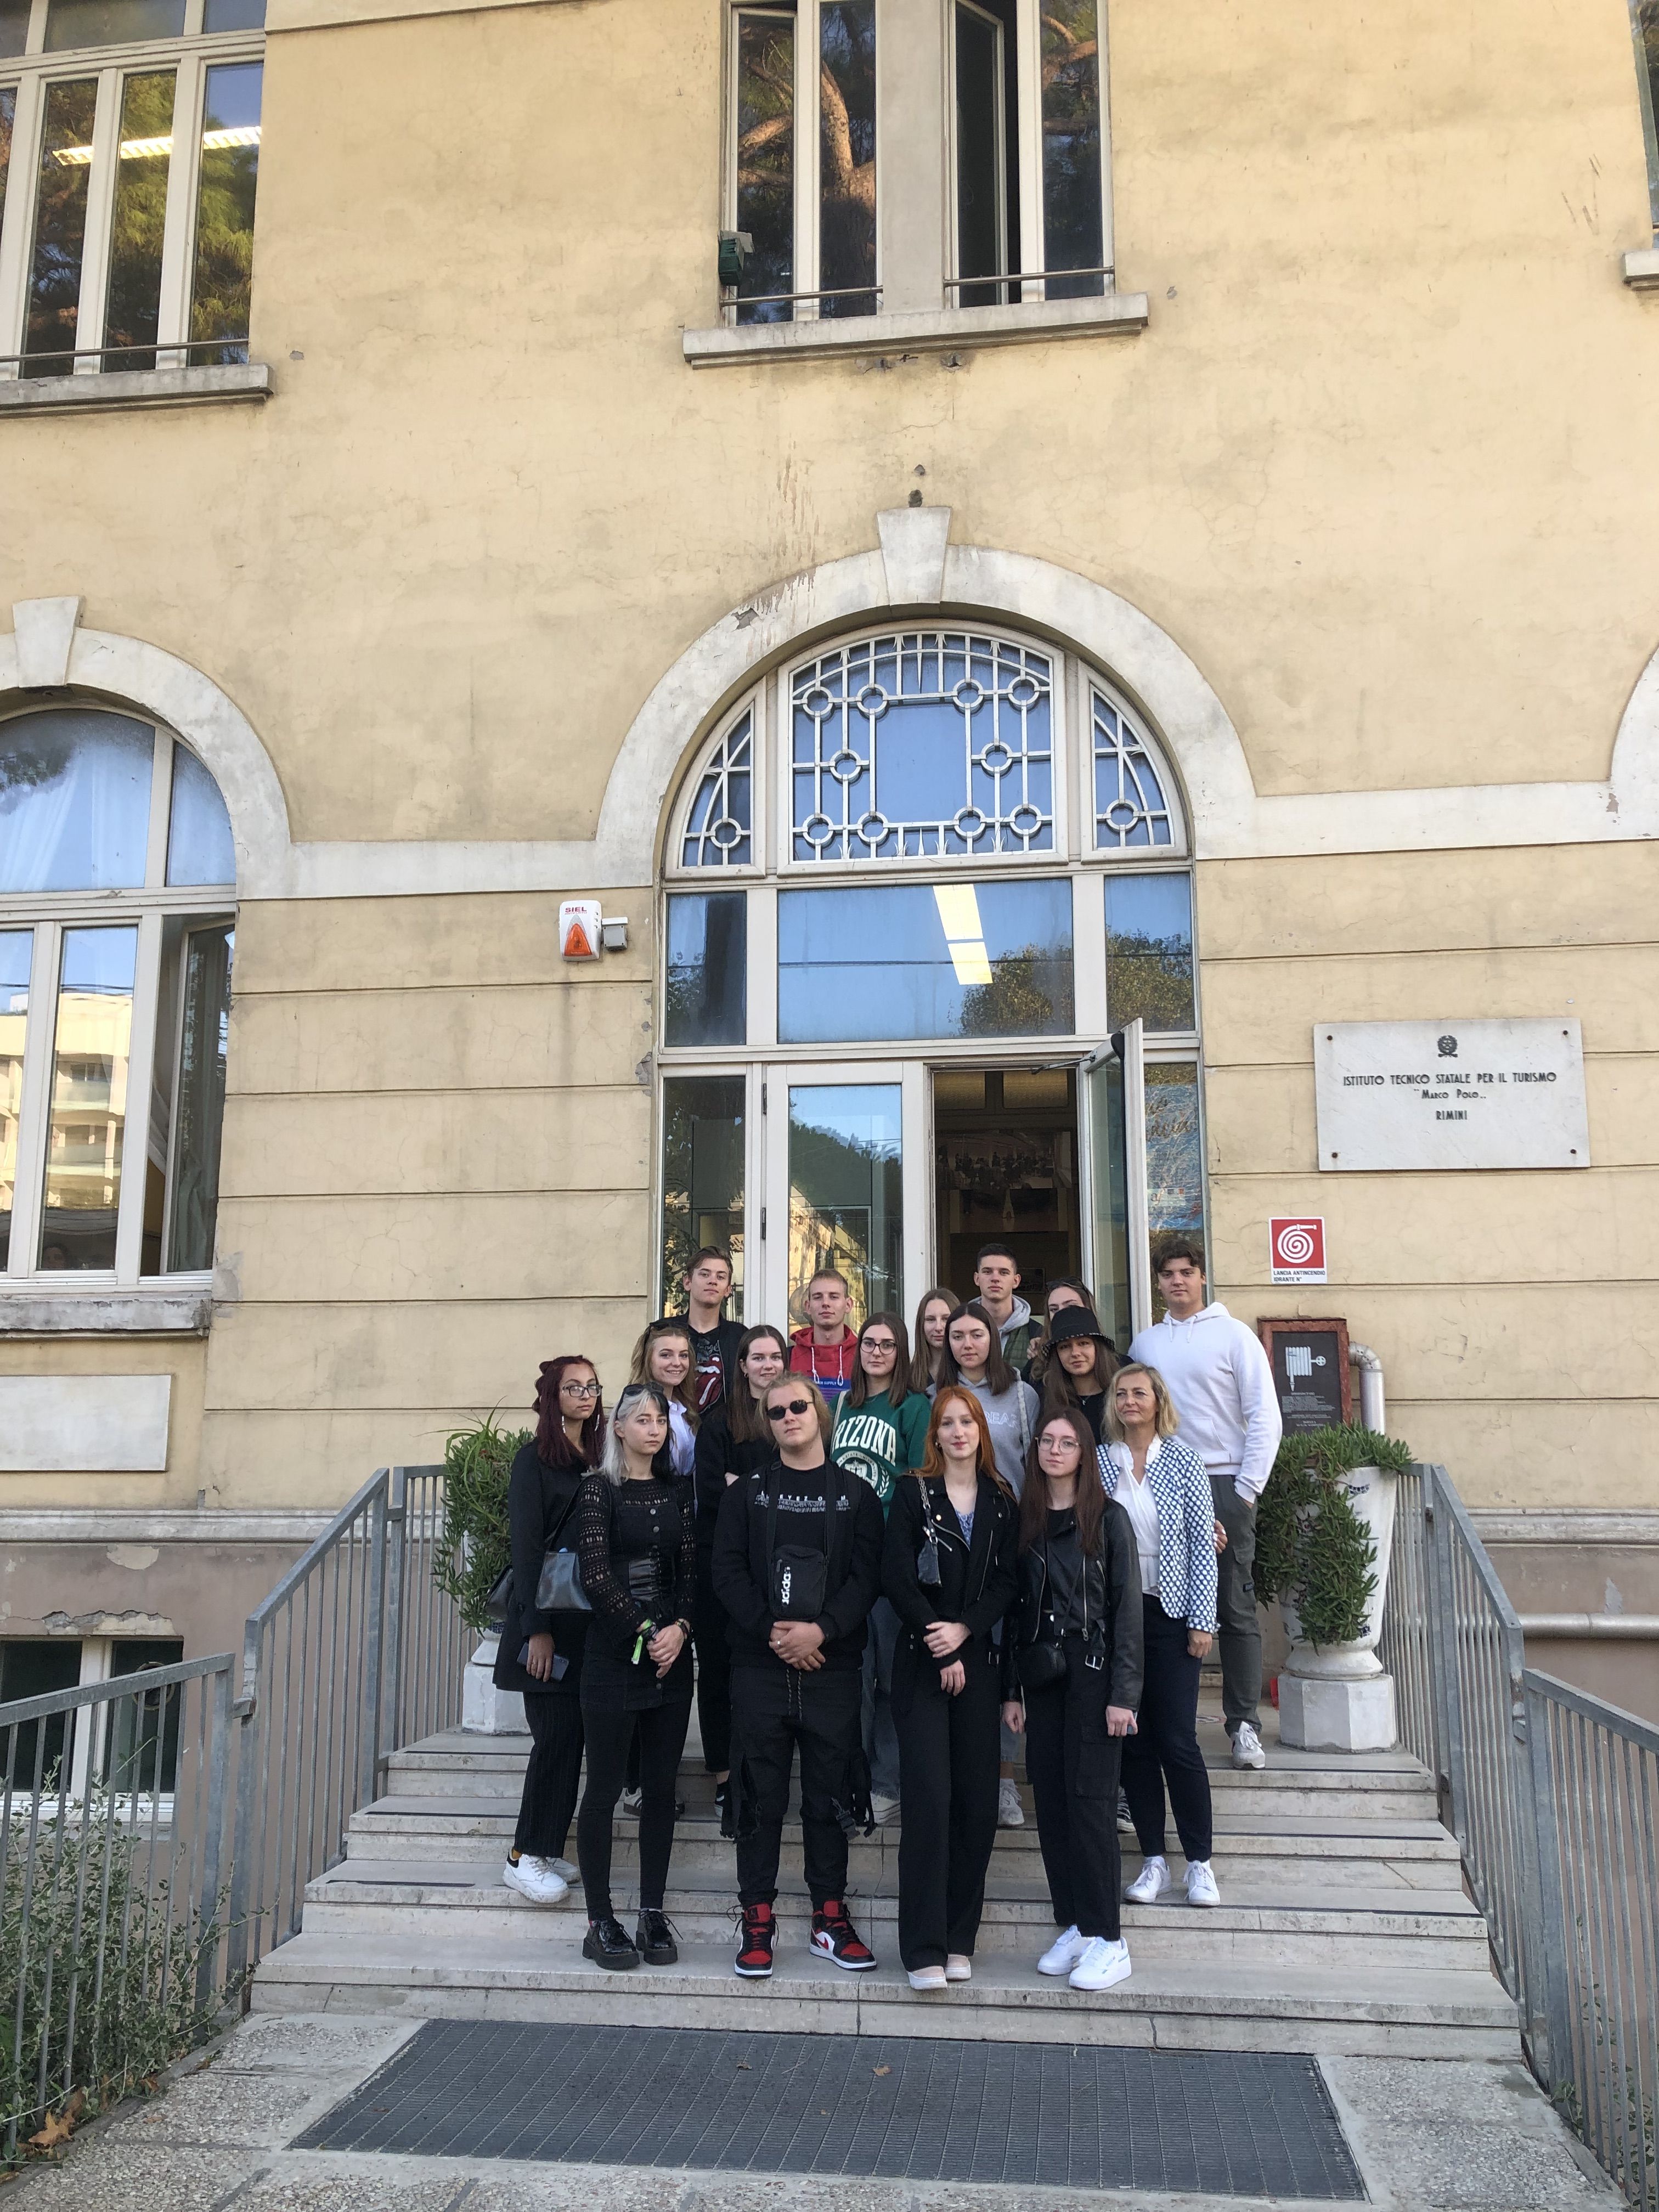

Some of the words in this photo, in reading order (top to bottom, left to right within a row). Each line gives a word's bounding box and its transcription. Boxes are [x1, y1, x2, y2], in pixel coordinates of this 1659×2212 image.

[1343, 1075, 1385, 1086] ISTITUTO
[1390, 1074, 1430, 1085] TECNICO
[1436, 1073, 1471, 1084] STATALE
[1477, 1073, 1494, 1084] PER
[1499, 1073, 1508, 1083] IL
[1513, 1072, 1556, 1082] TURISMO
[1436, 1110, 1468, 1120] RIMINI
[832, 1415, 896, 1468] RIZONA
